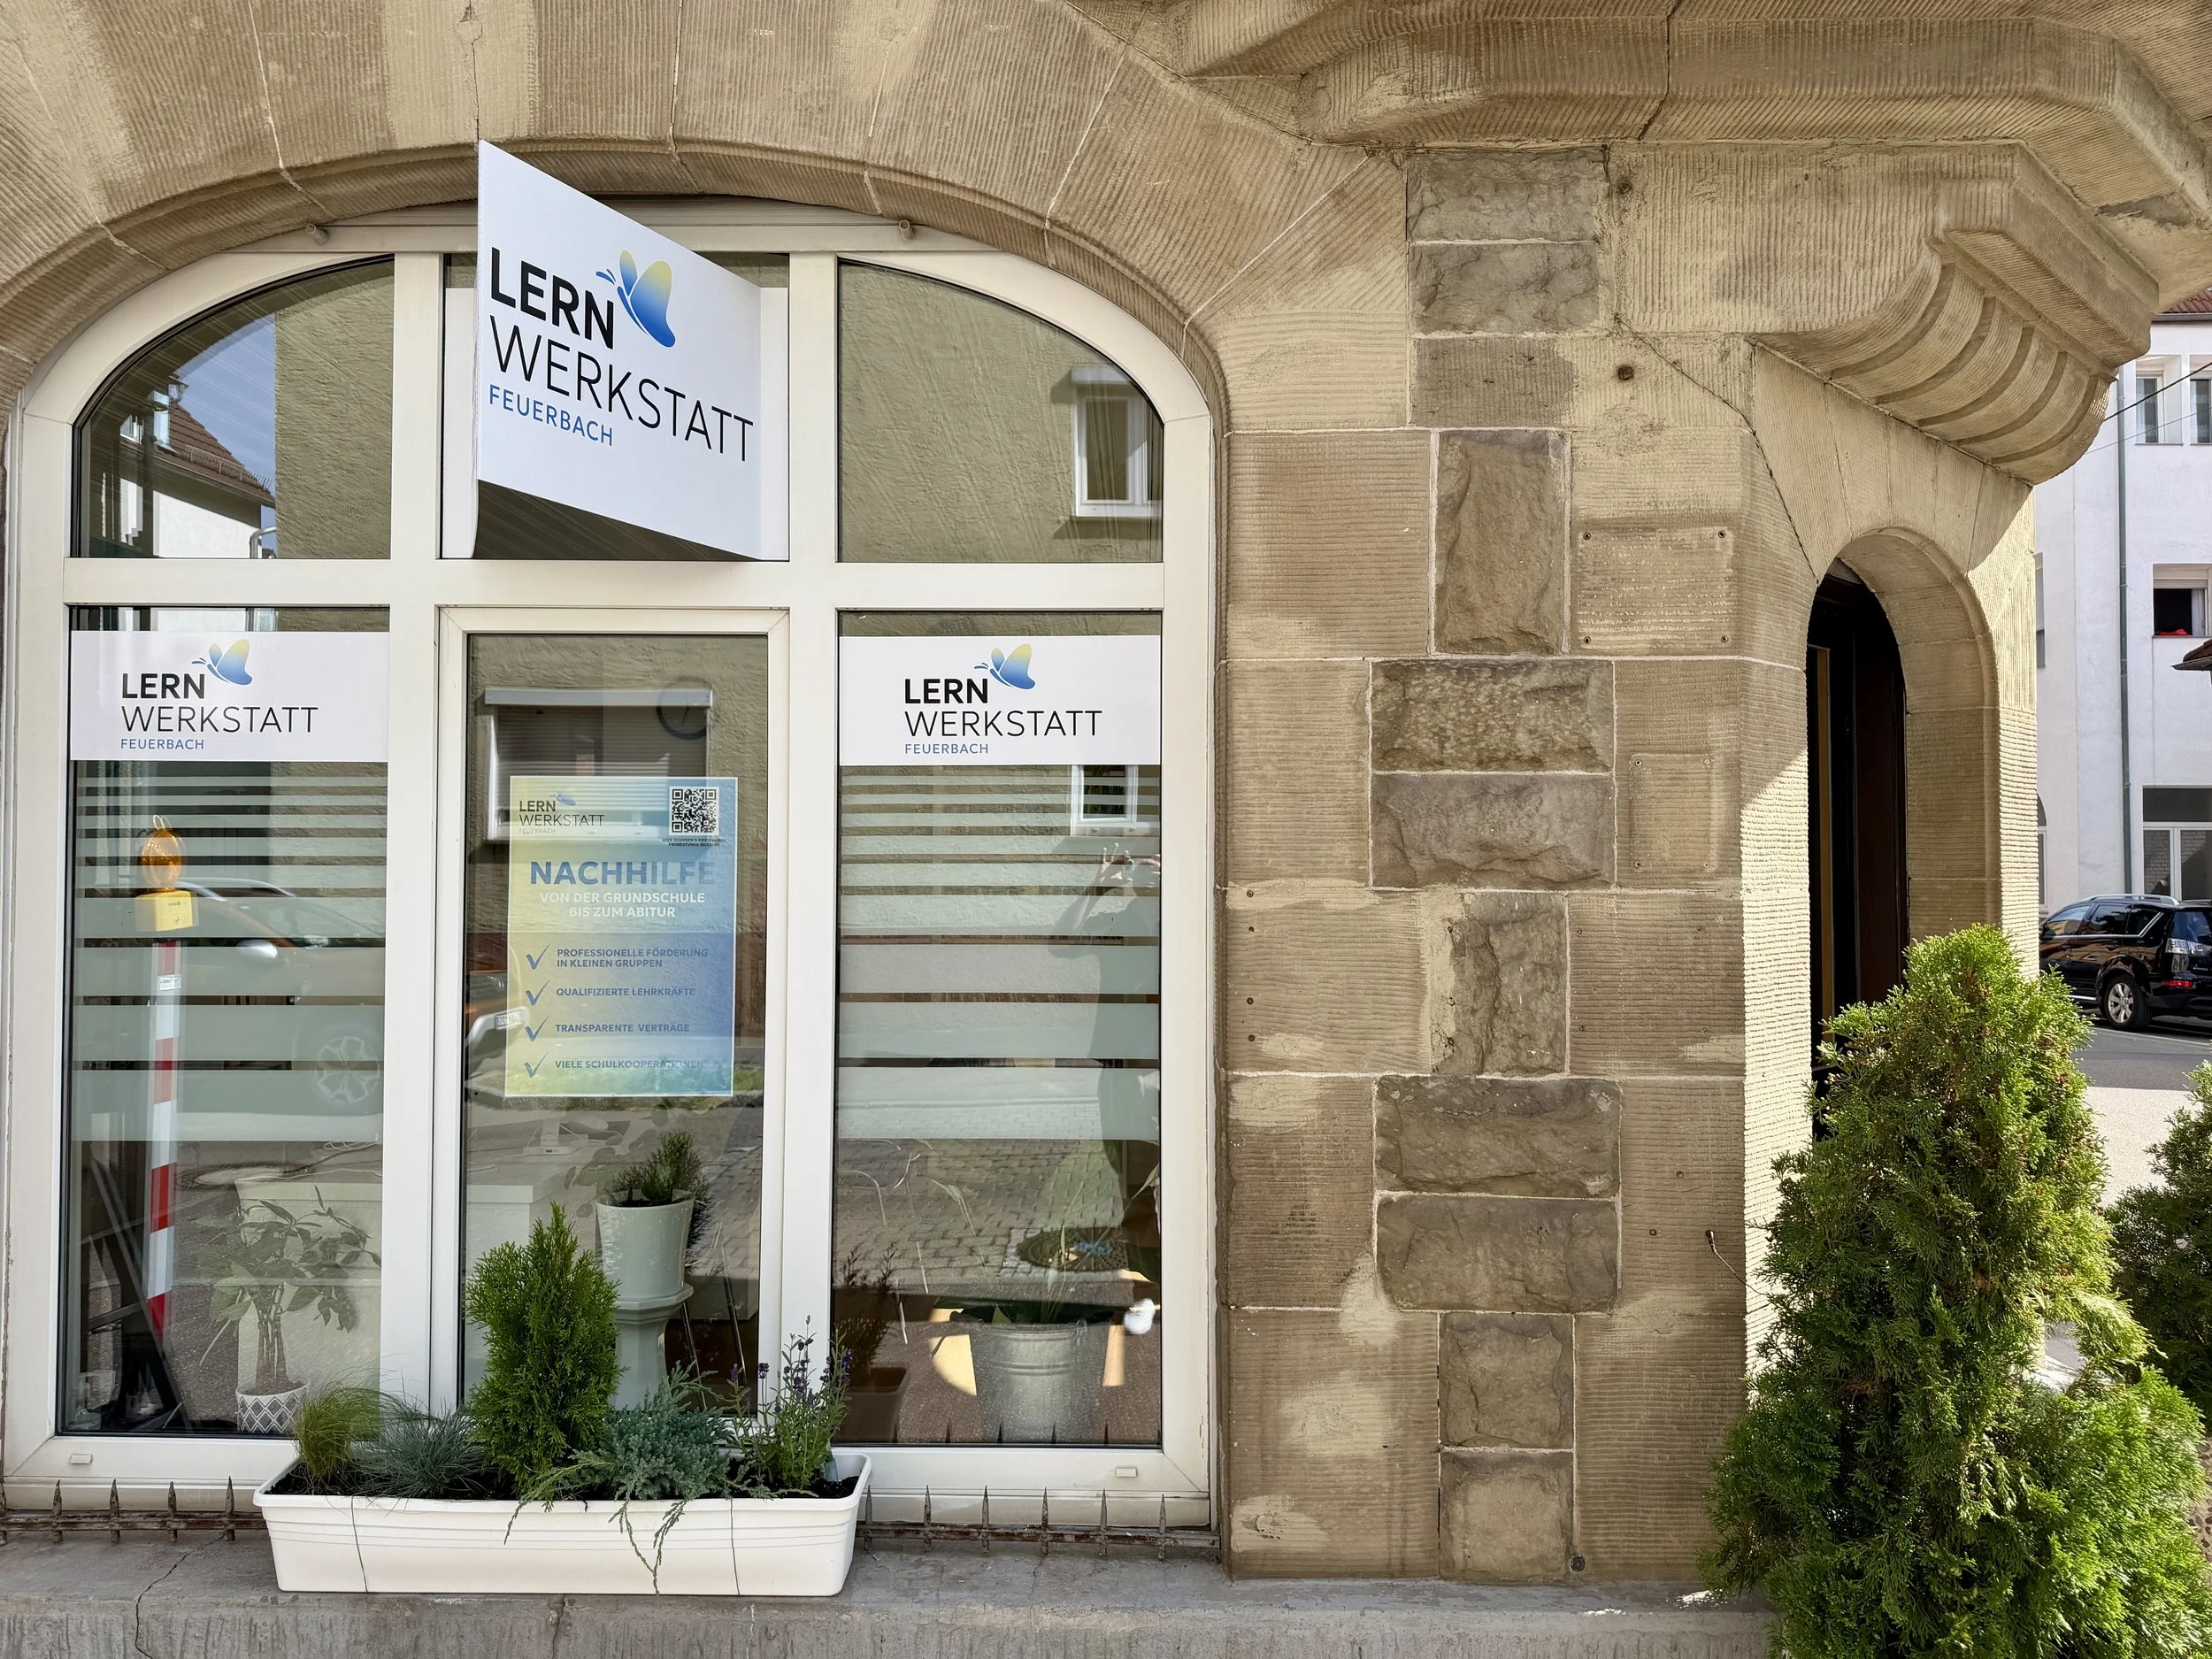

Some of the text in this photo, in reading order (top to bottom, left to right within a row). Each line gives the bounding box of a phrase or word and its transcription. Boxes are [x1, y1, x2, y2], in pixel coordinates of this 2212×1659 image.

[490, 247, 614, 350] LERN
[489, 314, 754, 462] WERKSTATT
[489, 384, 613, 447] FEUERBACH
[121, 672, 205, 699] LERN
[904, 678, 988, 704] LERN
[120, 705, 319, 733] WERKSTATT
[903, 710, 1102, 737] WERKSTATT
[120, 738, 204, 750] FEUERBACH
[904, 743, 989, 755] FEUERBACH
[518, 800, 557, 812] LERN
[518, 814, 605, 826] WERKSTATT
[530, 861, 716, 886] NACHHILFE
[540, 892, 705, 903] VON DER GRUNDSCHULE
[569, 906, 676, 918] BIS ZUM ABITUR
[557, 946, 709, 957] PROFESSIONELLE FÖRDERUNG
[556, 986, 696, 996] QUALIFIZIERTE LEHRKRÄFTE
[556, 1022, 690, 1033] TRANSPARENTE VERTRÄGE
[555, 1059, 703, 1069] VIELE SCHULKOOPERATIONEN
